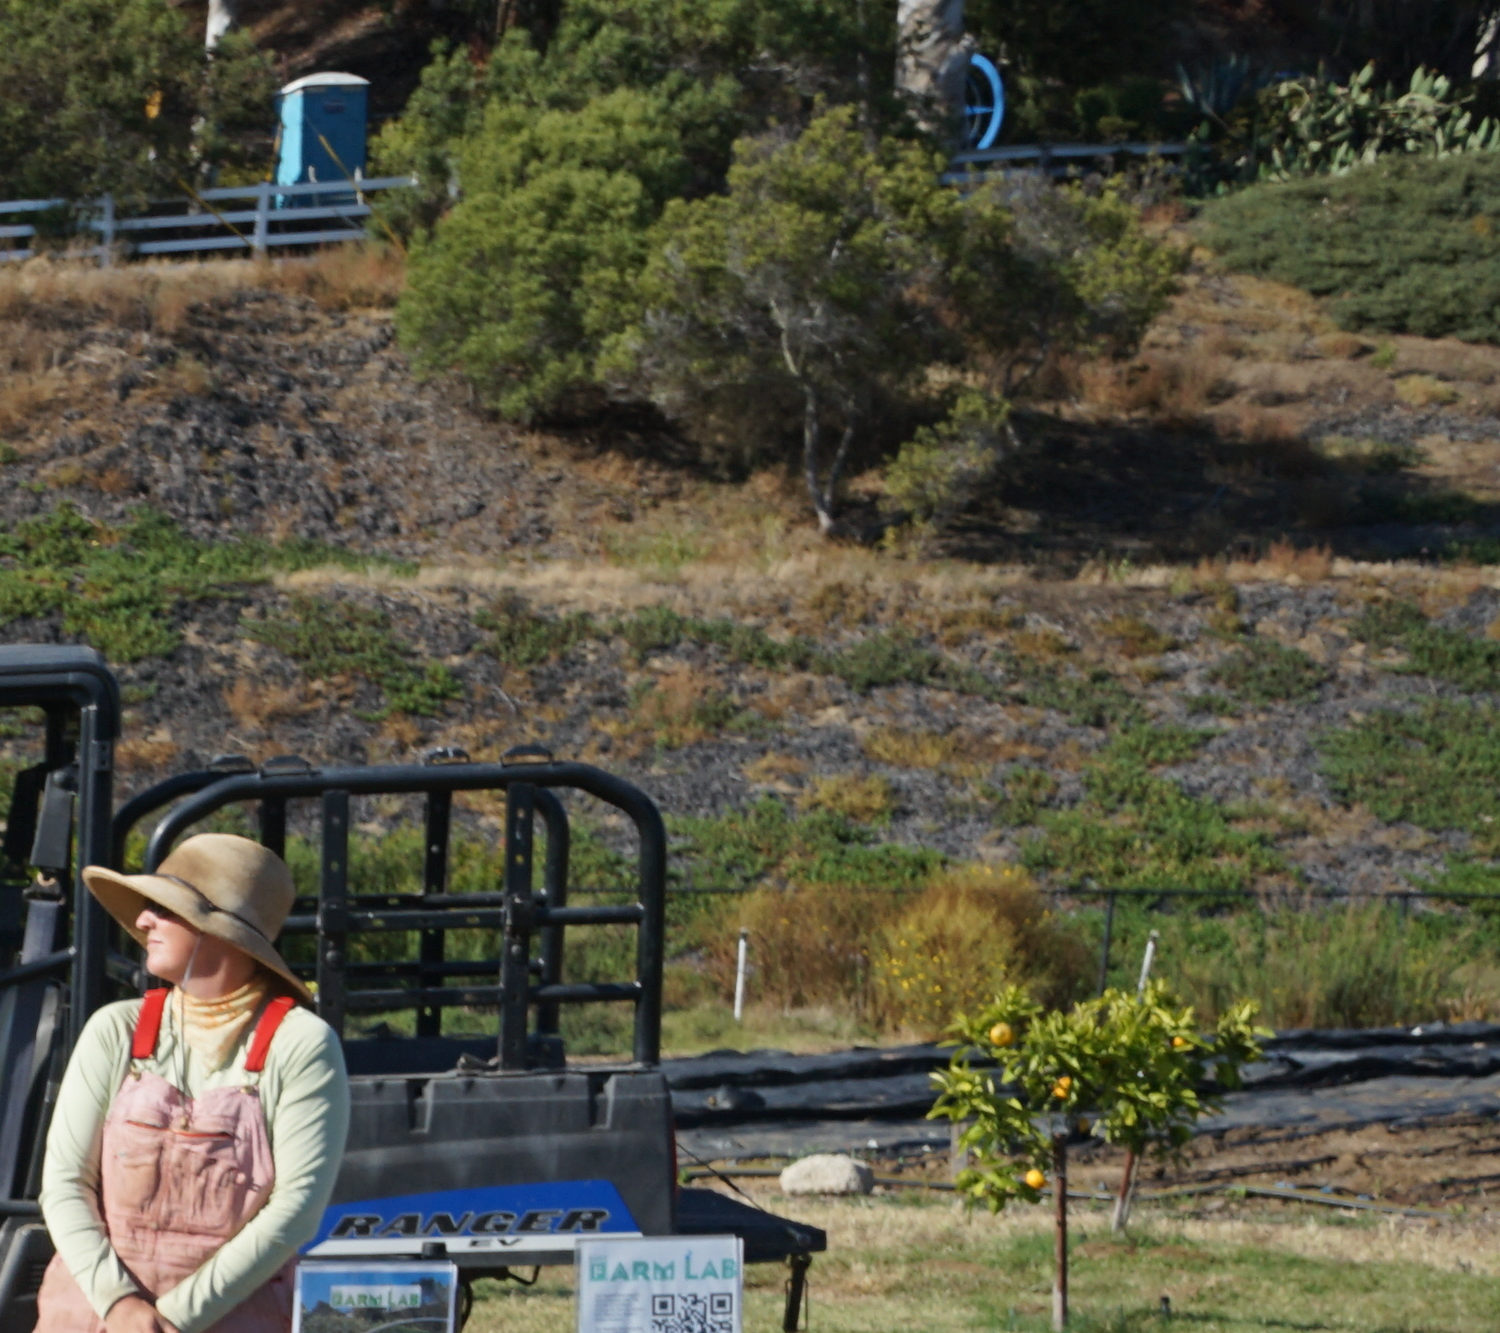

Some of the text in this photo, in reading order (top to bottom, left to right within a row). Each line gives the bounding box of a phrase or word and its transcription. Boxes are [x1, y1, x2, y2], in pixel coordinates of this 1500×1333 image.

[328, 1209, 610, 1238] RANGER
[468, 1238, 522, 1247] EV
[684, 1252, 738, 1281] LAB
